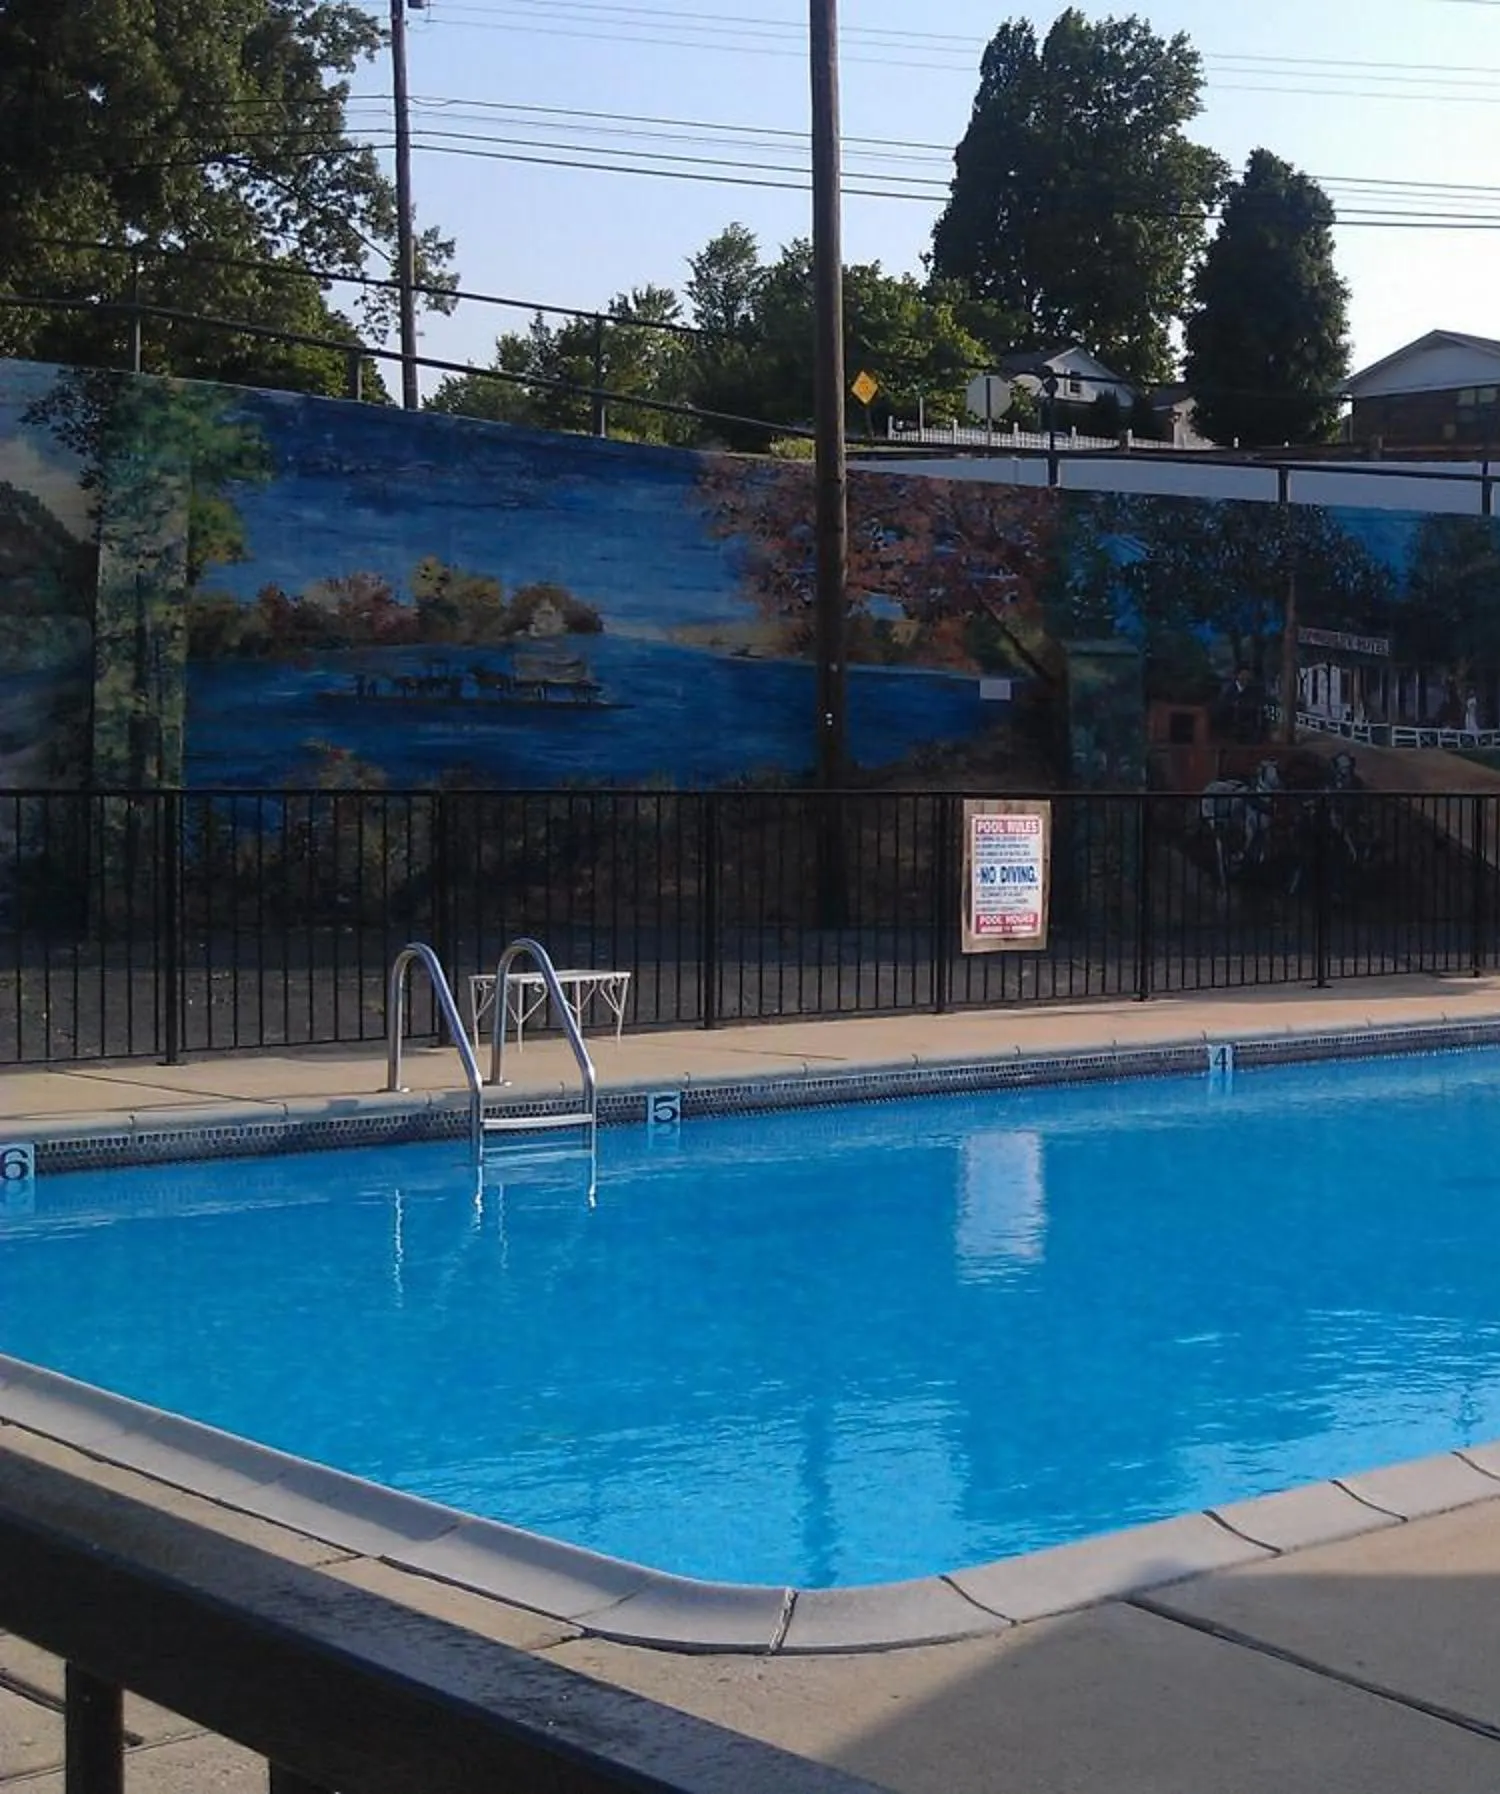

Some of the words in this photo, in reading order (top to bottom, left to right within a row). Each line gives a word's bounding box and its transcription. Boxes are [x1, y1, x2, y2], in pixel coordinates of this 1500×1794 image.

[977, 821, 1005, 833] POOL
[1007, 821, 1037, 833] RULES
[980, 866, 997, 884] NO
[1214, 1047, 1228, 1075] 4
[653, 1095, 678, 1123] 5
[0, 1148, 29, 1181] 6
